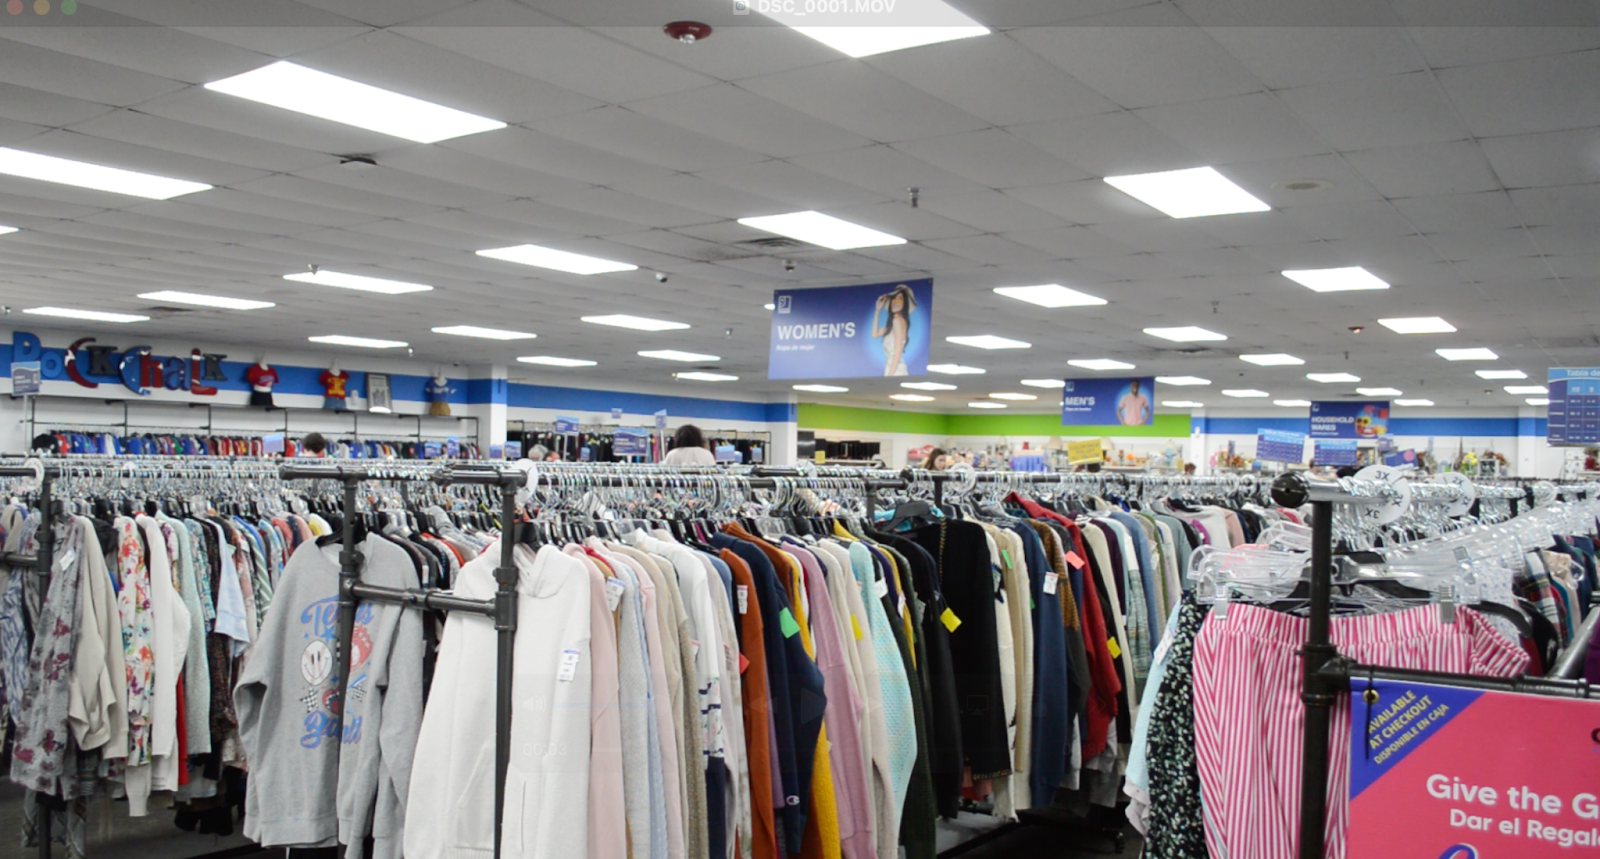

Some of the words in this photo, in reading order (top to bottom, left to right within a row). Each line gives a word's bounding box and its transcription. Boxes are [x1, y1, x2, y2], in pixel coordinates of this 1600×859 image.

[777, 322, 856, 340] WOMEN'S
[1065, 397, 1095, 406] MEN'S
[1374, 470, 1390, 481] 3X
[301, 594, 374, 637] Teas
[1368, 690, 1416, 734] AVAILABLE
[1368, 734, 1383, 750] AT
[1381, 694, 1432, 739] CHECKOUT
[1373, 726, 1419, 765] DISPONIBLE
[1416, 717, 1431, 731] EN
[1427, 703, 1450, 721] CAJA
[1426, 773, 1498, 806] Give
[1506, 785, 1562, 814] the
[1449, 808, 1493, 832] Dar
[1499, 817, 1519, 836] el
[1527, 819, 1600, 848] Regal
